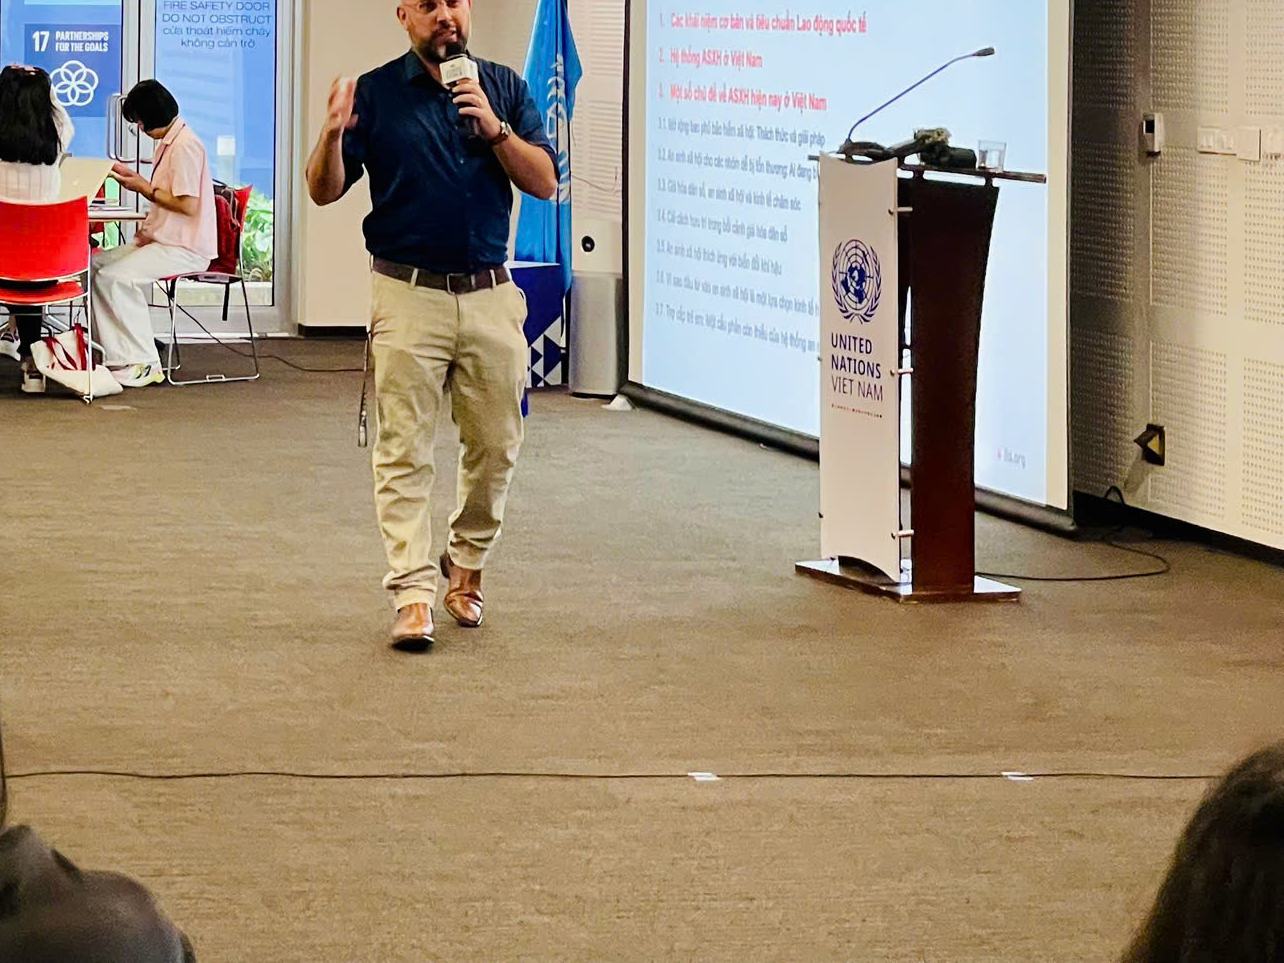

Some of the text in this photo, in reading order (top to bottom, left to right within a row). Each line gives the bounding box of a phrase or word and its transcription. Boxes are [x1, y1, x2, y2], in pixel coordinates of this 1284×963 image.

[164, 0, 270, 11] FIRE SAFETY DOOR
[162, 13, 271, 25] DO NOT OBSTRUCT
[797, 14, 811, 31] Lao
[32, 30, 50, 52] 17
[55, 31, 109, 41] PARTNERSHIPS
[55, 42, 109, 52] FOR THE GOALS
[702, 49, 722, 66] ASXH
[728, 87, 749, 105] ASXH
[809, 93, 827, 110] Nam
[831, 332, 872, 354] UNITED
[831, 354, 882, 379] NATIONS
[831, 375, 883, 402] VIET NAM
